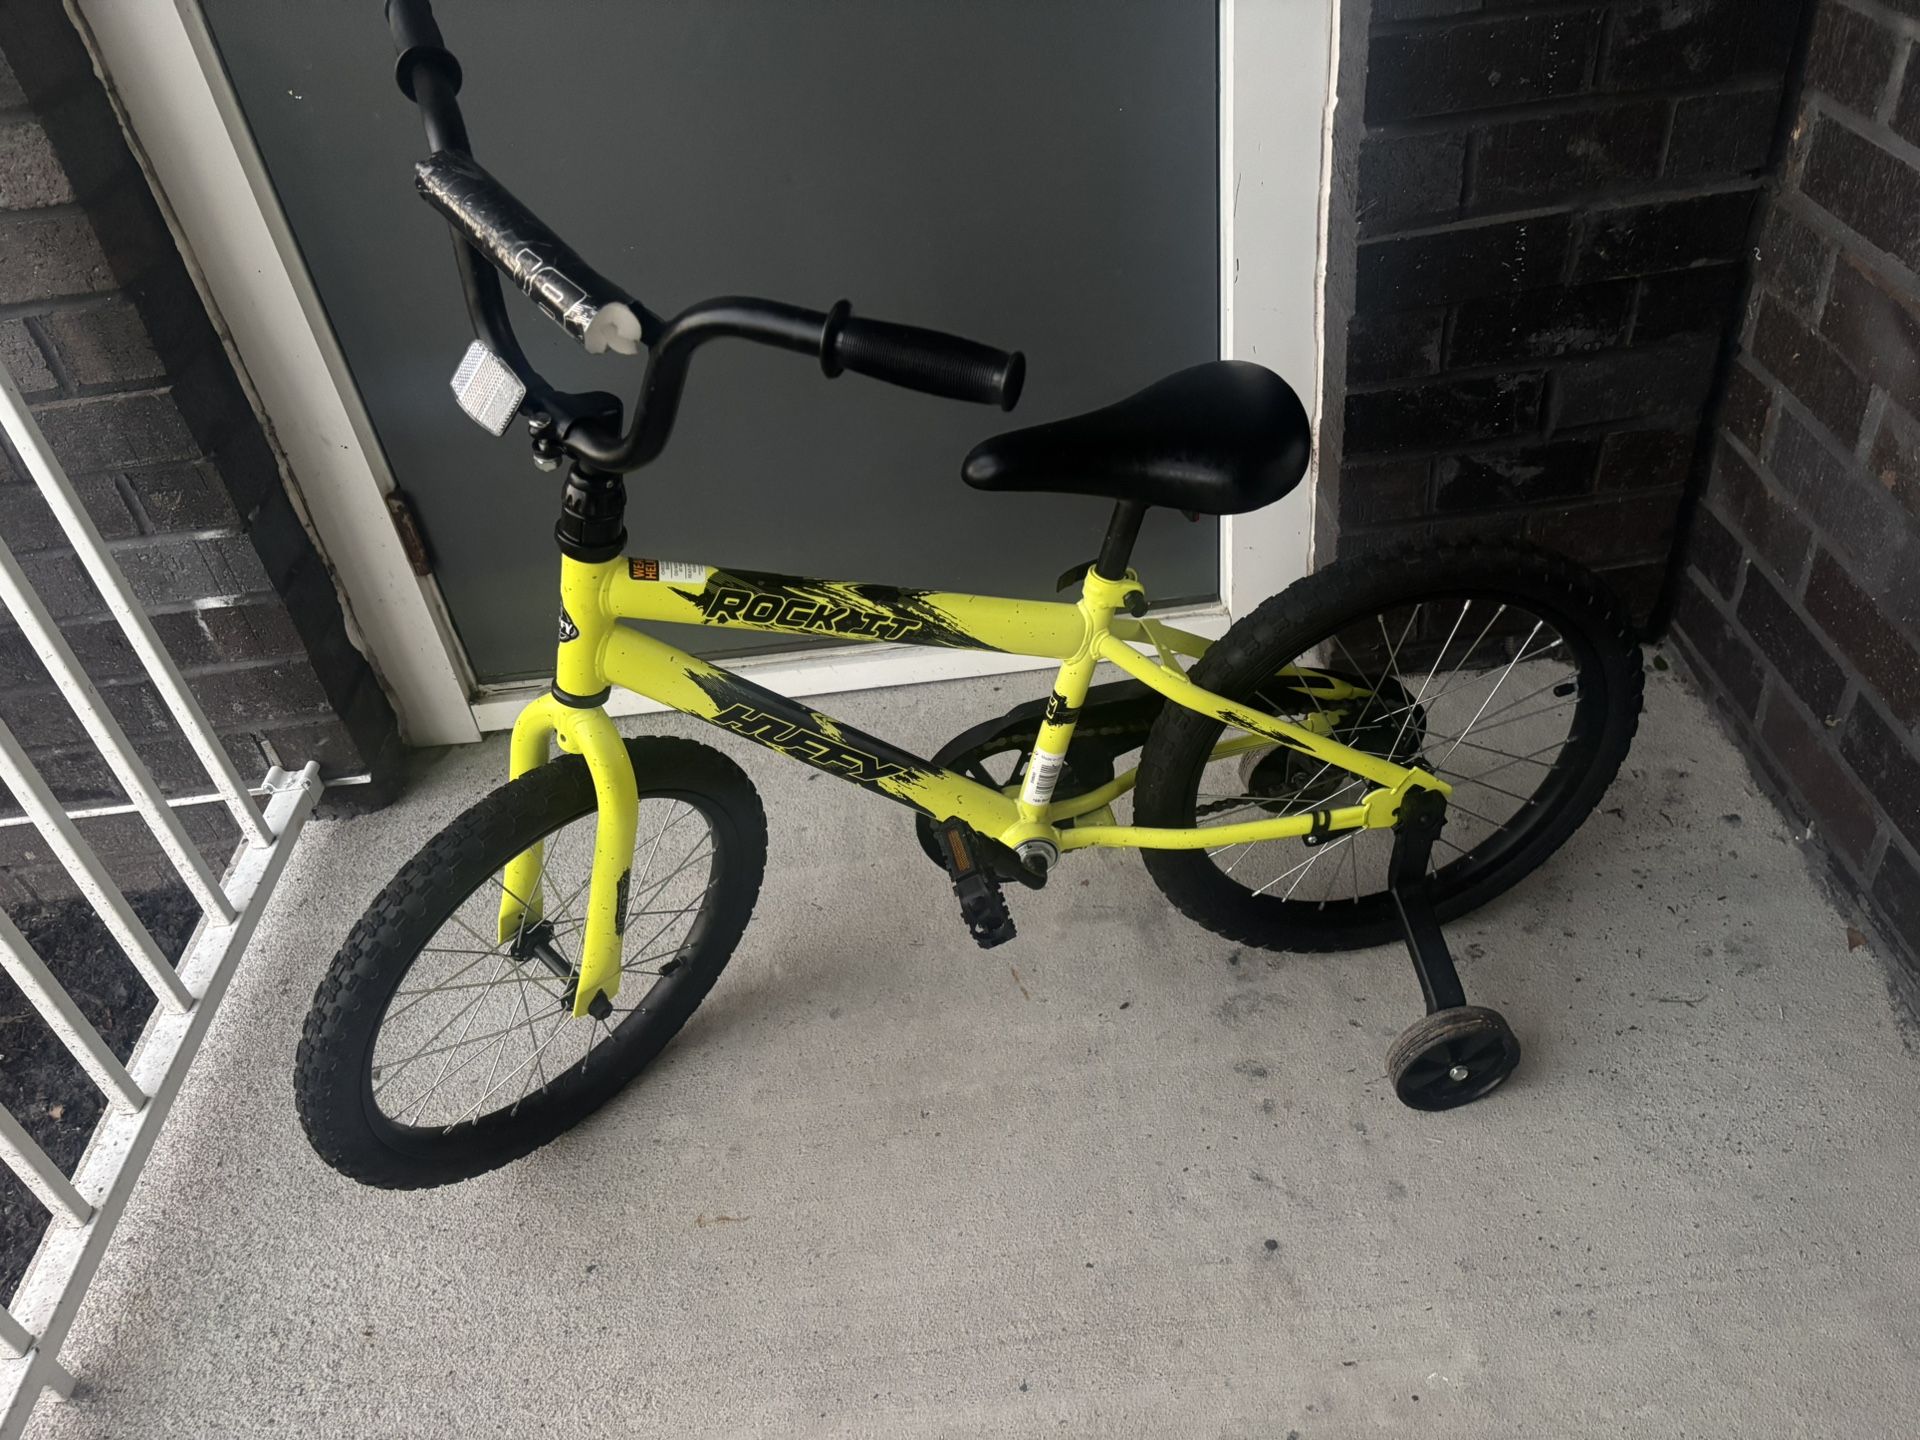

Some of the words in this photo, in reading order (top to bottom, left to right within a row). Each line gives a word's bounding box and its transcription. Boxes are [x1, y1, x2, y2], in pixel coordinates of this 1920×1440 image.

[645, 560, 657, 579] HEL
[705, 587, 850, 632] ROCK
[848, 611, 922, 641] IT
[711, 703, 908, 782] HUFFY
